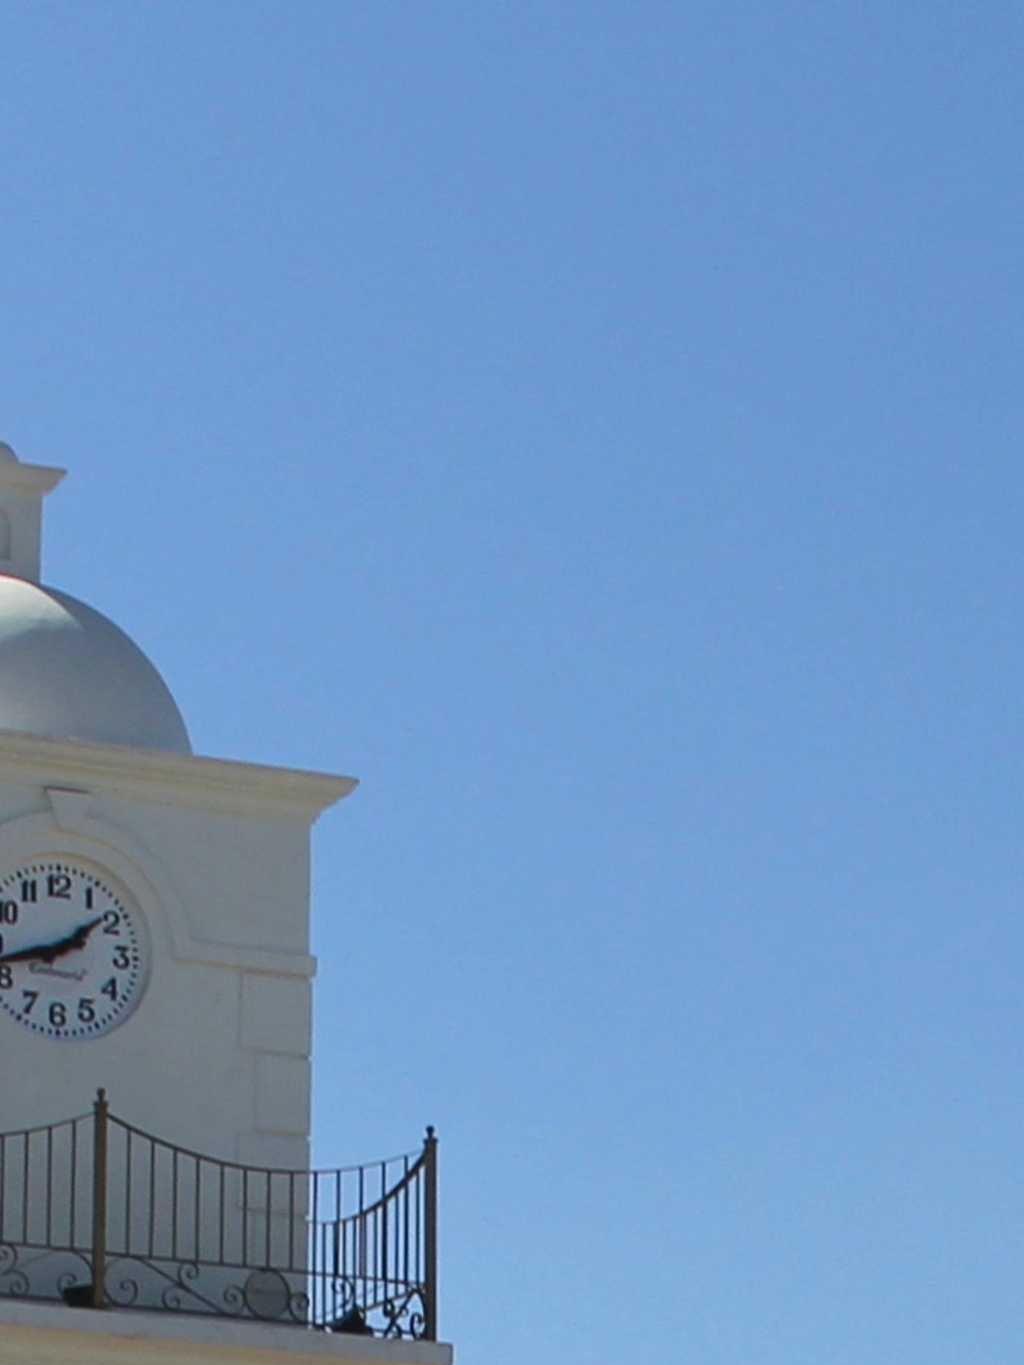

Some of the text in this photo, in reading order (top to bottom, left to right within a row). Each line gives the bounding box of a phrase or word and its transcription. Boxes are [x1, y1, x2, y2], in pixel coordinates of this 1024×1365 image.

[22, 880, 37, 902] 11
[48, 874, 71, 899] 12
[86, 888, 93, 909] 1
[0, 900, 18, 925] 0
[102, 910, 120, 936] 2
[113, 946, 129, 970] 3
[0, 965, 13, 989] 8
[101, 977, 118, 1002] 4
[22, 990, 38, 1014] 7
[78, 998, 95, 1022] 5
[49, 1002, 66, 1027] 6
